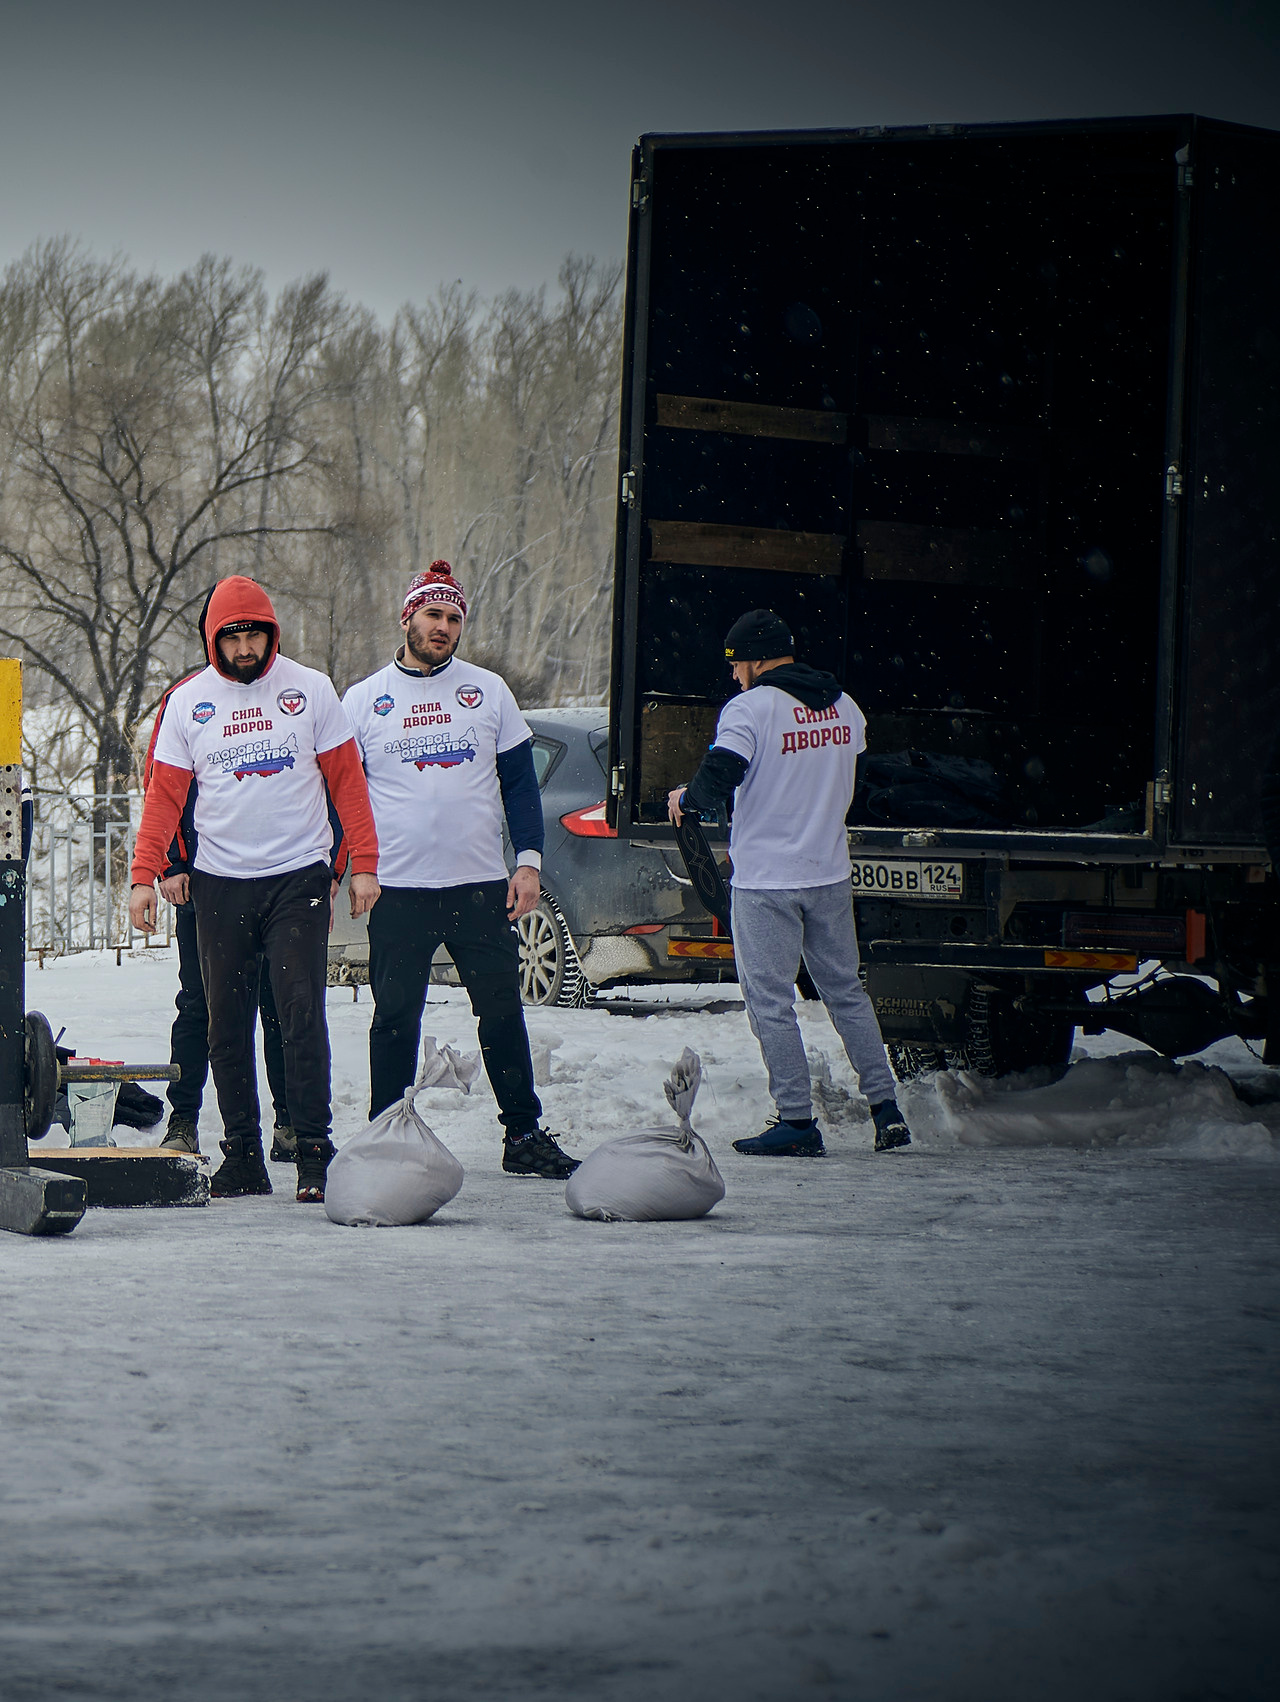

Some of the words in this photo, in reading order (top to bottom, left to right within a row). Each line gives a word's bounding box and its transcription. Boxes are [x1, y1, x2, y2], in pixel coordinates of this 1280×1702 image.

[231, 707, 263, 721] СИЛА
[411, 702, 442, 714] СИЛА
[793, 704, 840, 725] СИЛА
[222, 720, 273, 738] ДВОРОВ
[403, 713, 452, 729] ДВОРОВ
[384, 732, 450, 754] ЗДОРОВОЕ
[400, 740, 469, 759] ОТЕЧЕСТВО
[781, 725, 851, 755] ДВОРОВ
[207, 739, 271, 765] ЗДОРОВОЕ
[222, 746, 291, 770] ОТЕЧЕСТВО
[923, 864, 957, 884] 124
[930, 884, 948, 892] RUS
